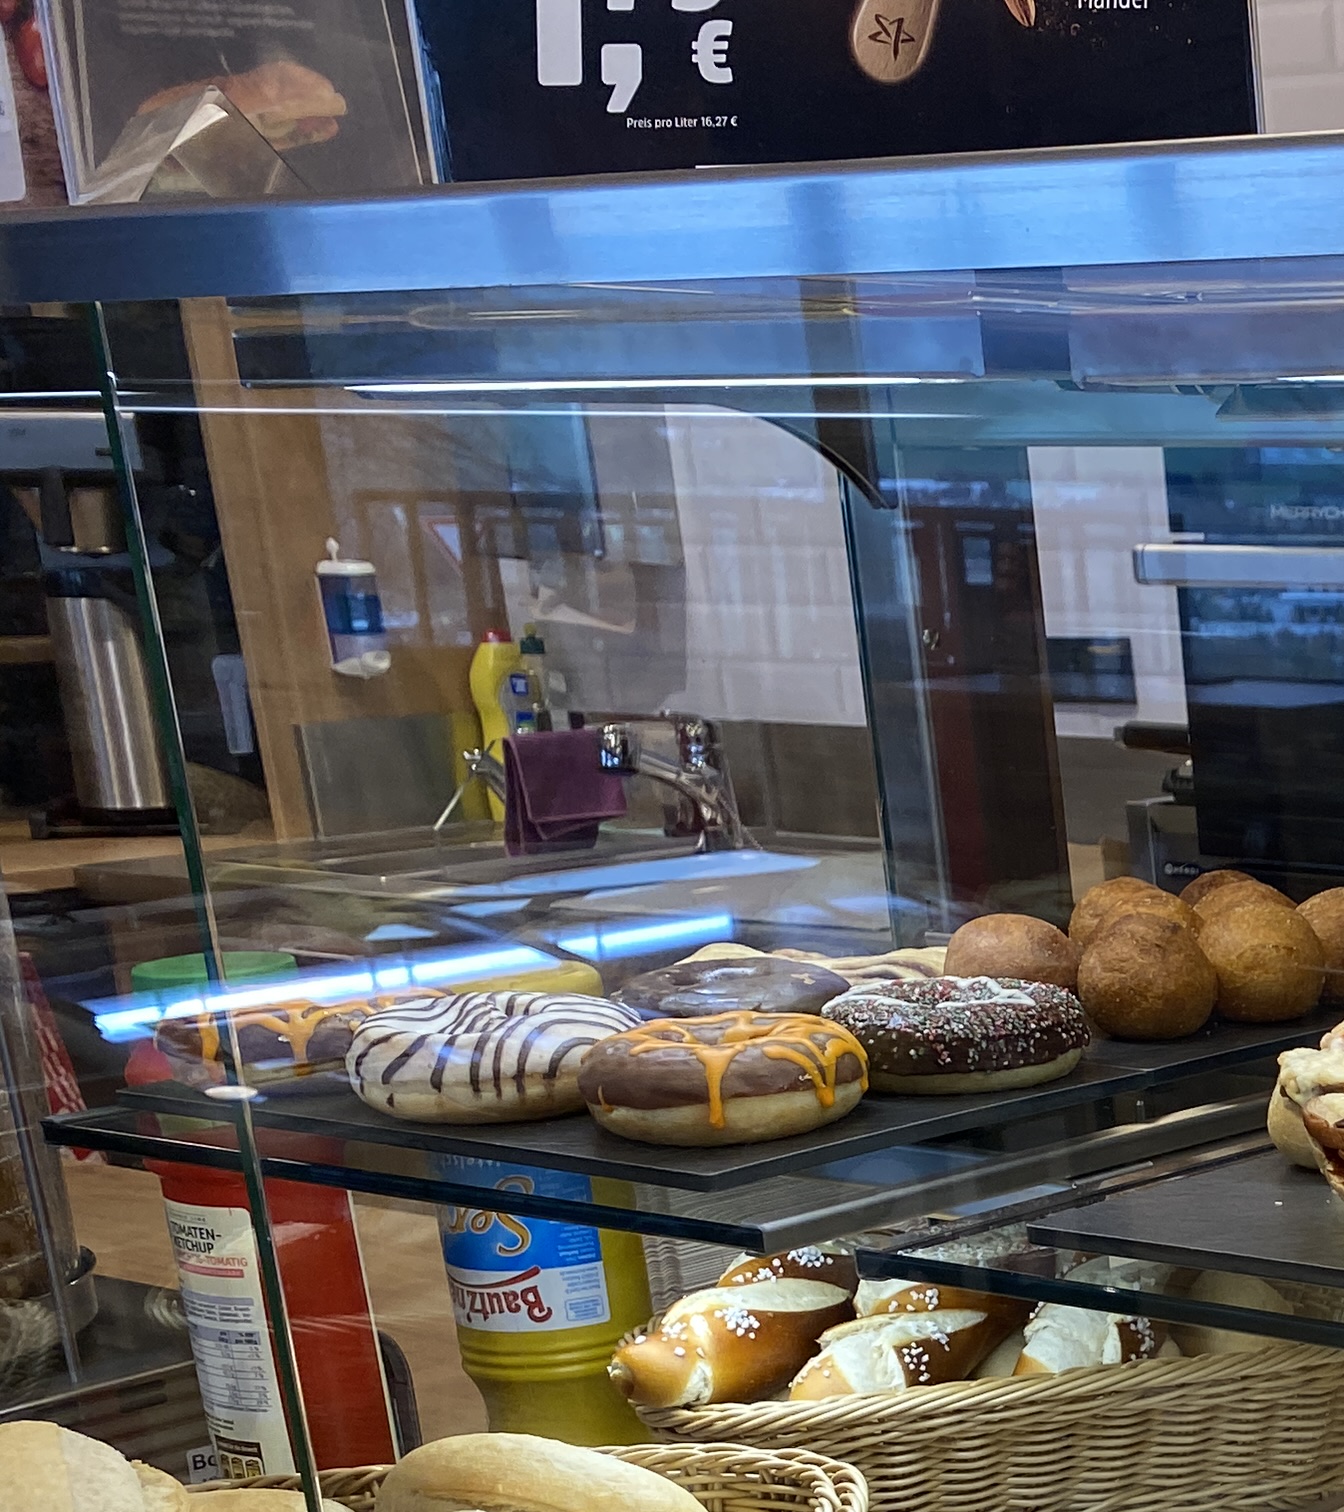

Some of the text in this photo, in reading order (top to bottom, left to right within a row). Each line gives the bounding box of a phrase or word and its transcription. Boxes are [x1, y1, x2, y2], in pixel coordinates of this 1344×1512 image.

[626, 117, 652, 128] Preis
[654, 119, 672, 129] pro
[674, 116, 698, 128] Liter
[730, 115, 738, 127] €
